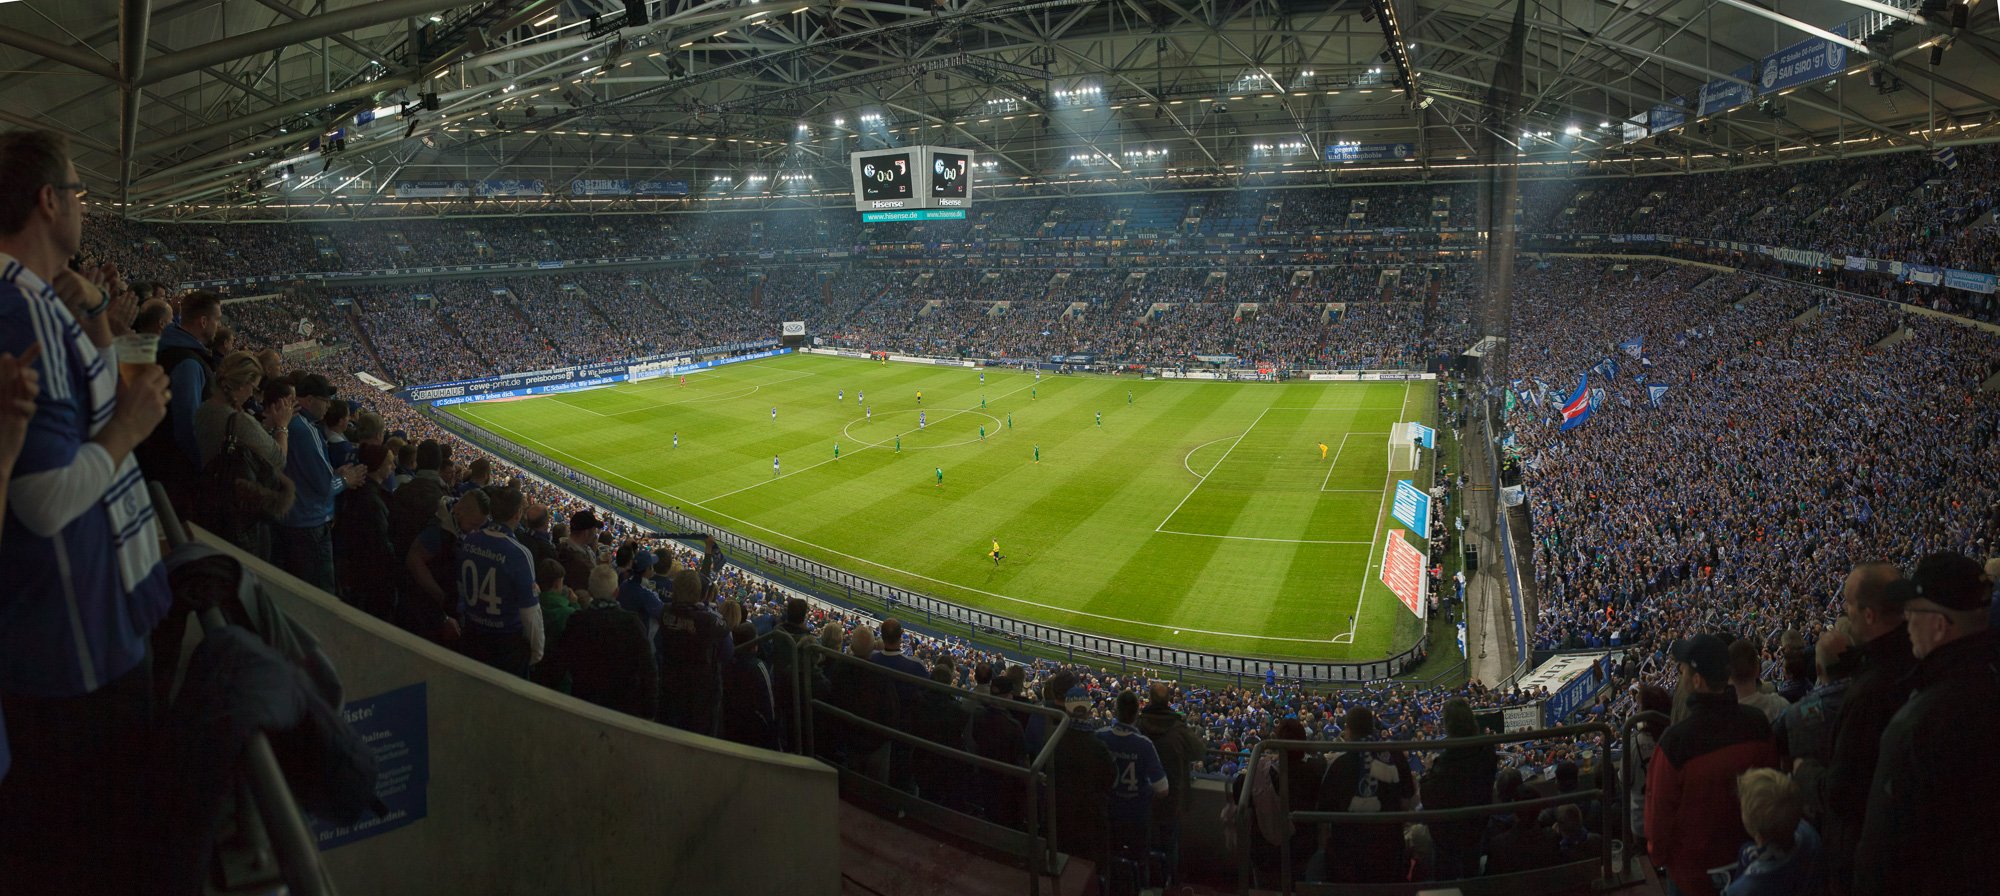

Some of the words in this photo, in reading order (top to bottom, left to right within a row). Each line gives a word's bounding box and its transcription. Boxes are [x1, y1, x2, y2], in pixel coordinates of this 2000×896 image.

[1786, 51, 1801, 62] Schalke
[1778, 65, 1793, 80] SAN
[1794, 60, 1812, 75] SIRO
[1812, 54, 1825, 69] '97
[1342, 152, 1382, 160] Homophobie
[872, 200, 904, 209] Hisense
[939, 198, 961, 206] Hisense
[867, 212, 918, 220] www.hisense.de
[1773, 246, 1824, 268] NORDKURVE
[1953, 279, 1984, 291] WENGERN
[419, 386, 464, 400] BAUHAUS
[469, 378, 521, 392] cewe-print.de
[526, 373, 566, 385] preisboerse
[551, 383, 570, 391] Schalke
[444, 397, 464, 405] Schalke
[470, 544, 497, 560] Schalke
[461, 559, 503, 616] 04
[1522, 657, 1576, 691] VELTIN
[343, 703, 375, 723] äste!
[361, 730, 393, 744] halten.
[320, 830, 334, 841] für
